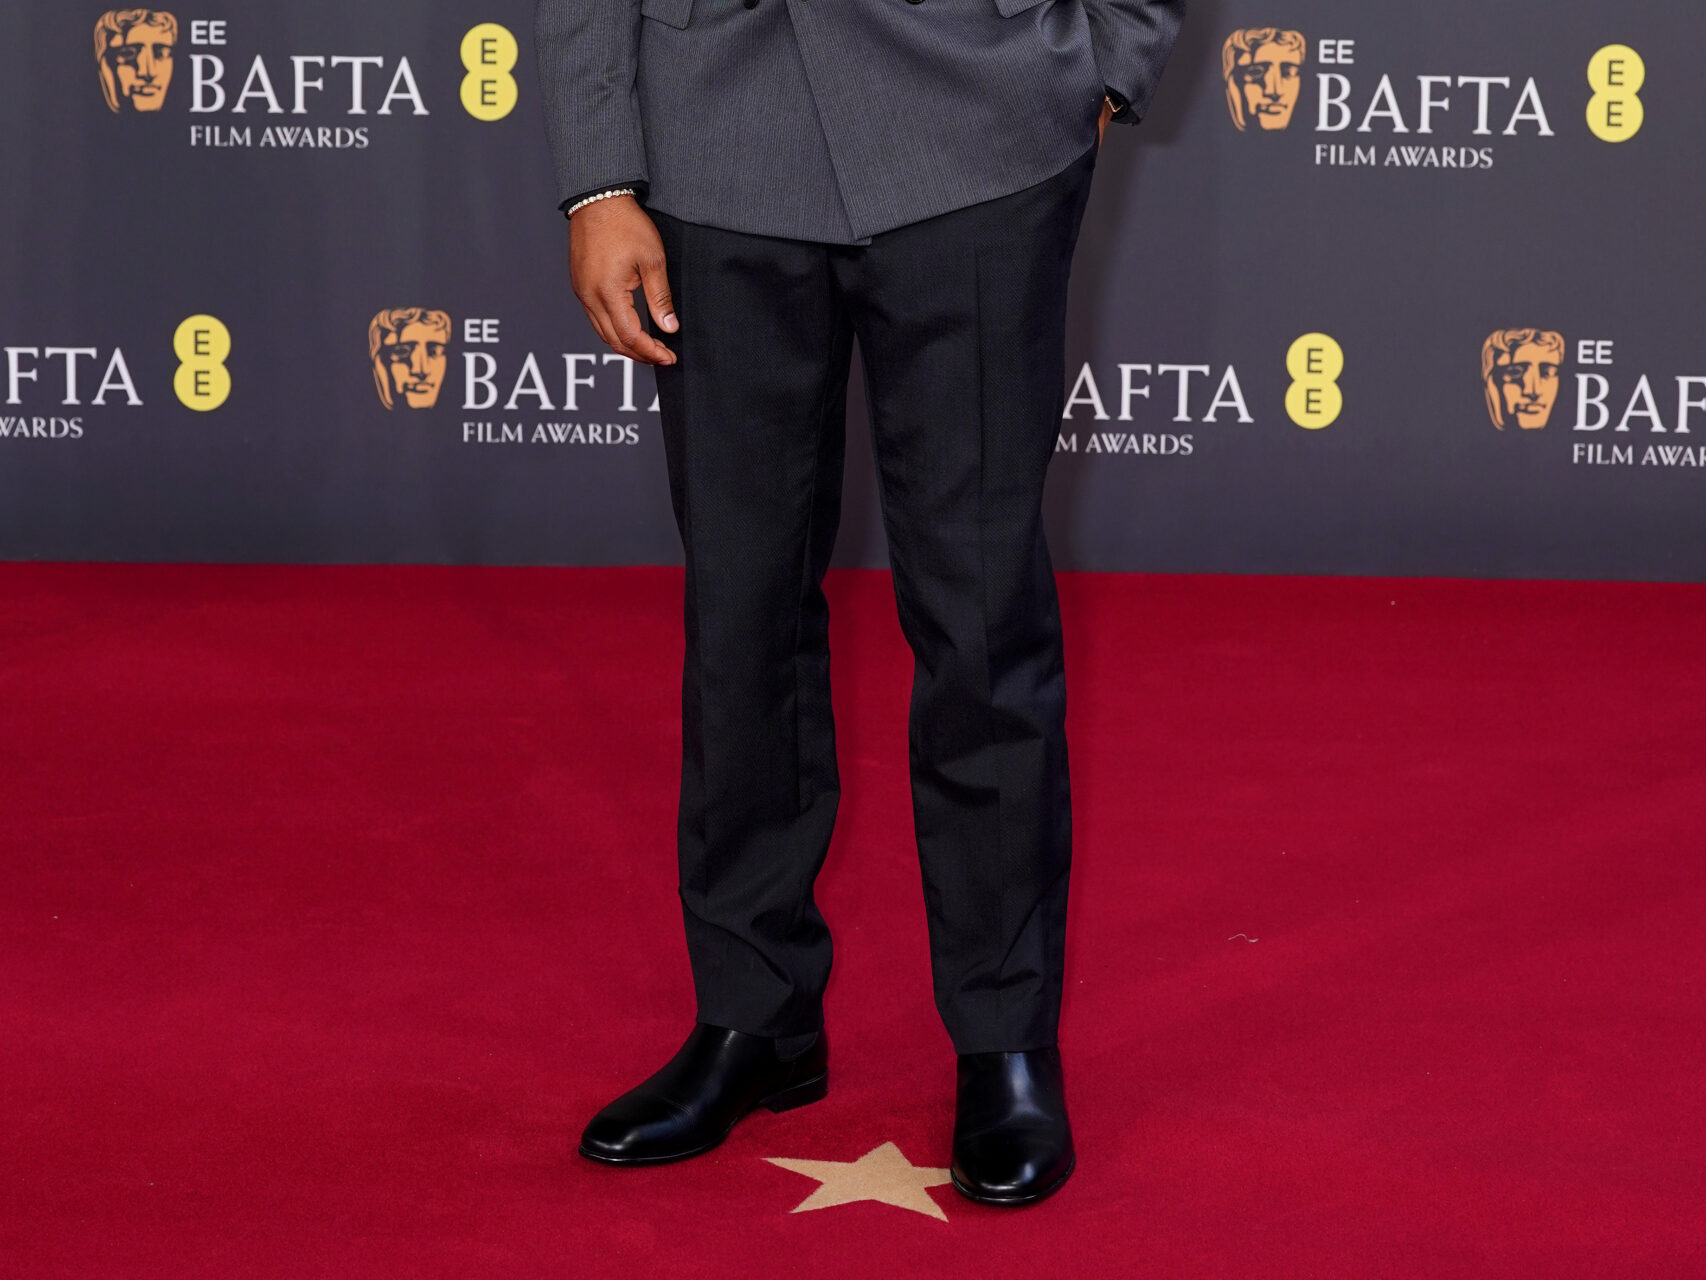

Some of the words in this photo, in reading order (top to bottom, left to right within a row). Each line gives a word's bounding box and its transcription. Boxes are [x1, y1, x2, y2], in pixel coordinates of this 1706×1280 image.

[190, 20, 227, 45] EE
[1318, 39, 1355, 65] EE
[189, 54, 430, 116] BAFTA
[1315, 72, 1555, 137] BAFTA
[190, 125, 252, 147] FILM
[259, 126, 369, 148] AWARDS
[1315, 143, 1376, 166] FILM
[1384, 145, 1494, 169] AWARDS
[464, 318, 500, 343] EE
[1577, 339, 1614, 365] EE
[3, 346, 144, 406] FTA
[462, 351, 661, 412] BAFT
[463, 422, 523, 443] FILM
[531, 422, 639, 445] AWARDS
[1085, 433, 1194, 455] AWARDS
[1573, 443, 1633, 465] FILM
